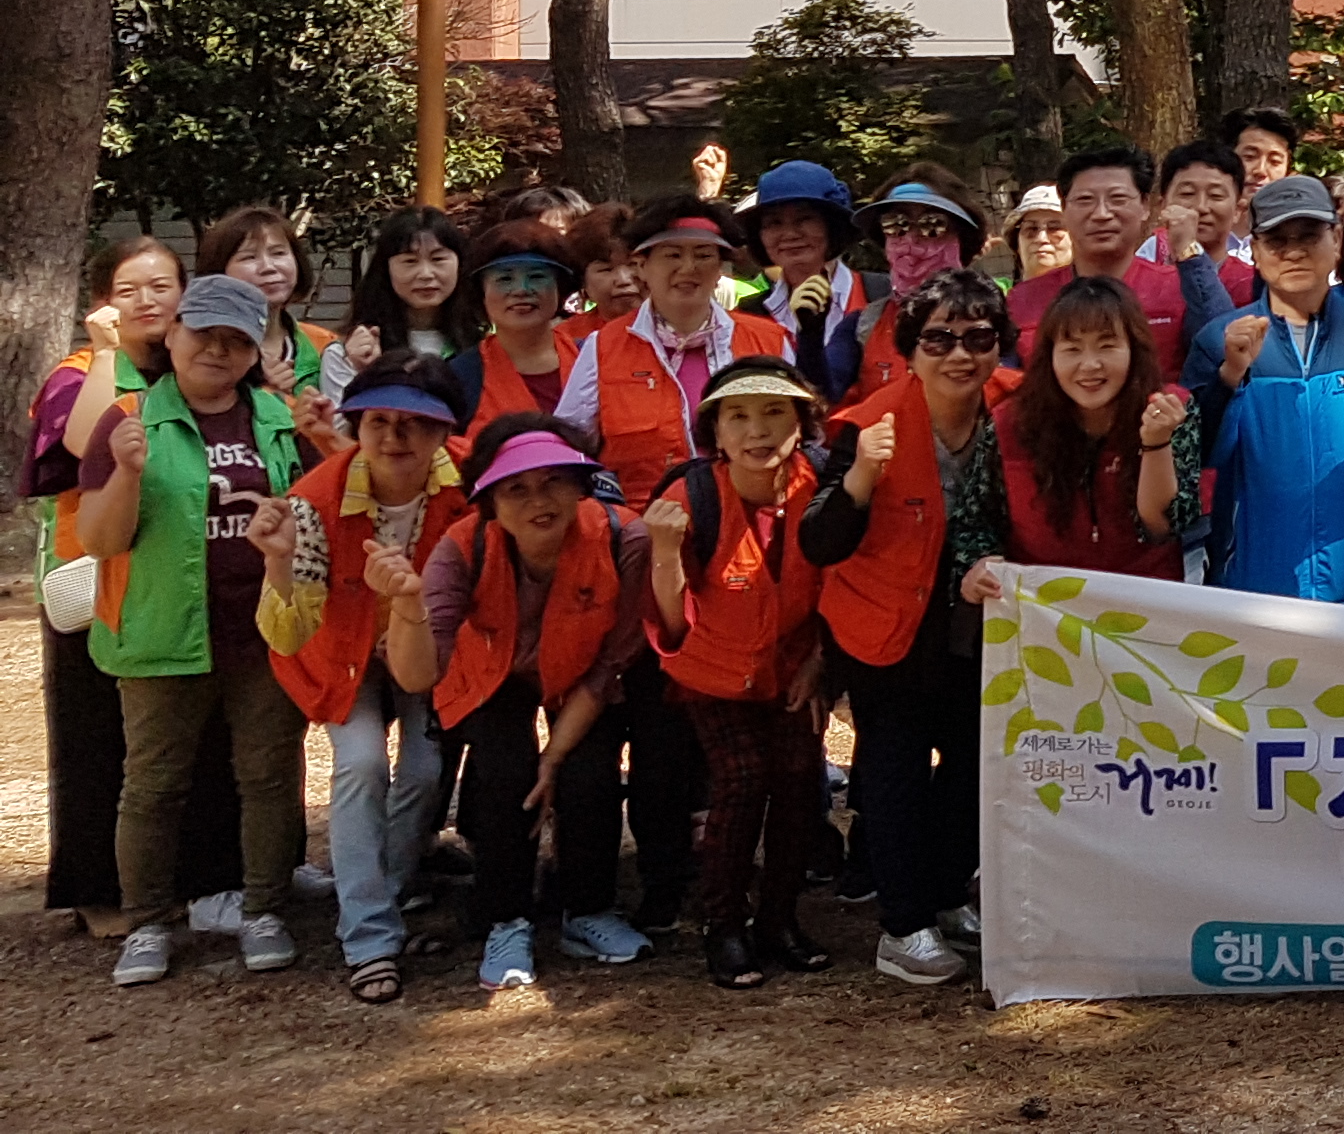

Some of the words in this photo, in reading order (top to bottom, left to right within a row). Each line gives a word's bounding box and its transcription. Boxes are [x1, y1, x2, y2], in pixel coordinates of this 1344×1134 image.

[1019, 734, 1075, 753] 세계로
[1077, 736, 1114, 756] 가는
[1022, 759, 1085, 782] 평화의
[1066, 782, 1111, 805] 도시
[1166, 799, 1213, 810] GEOJE
